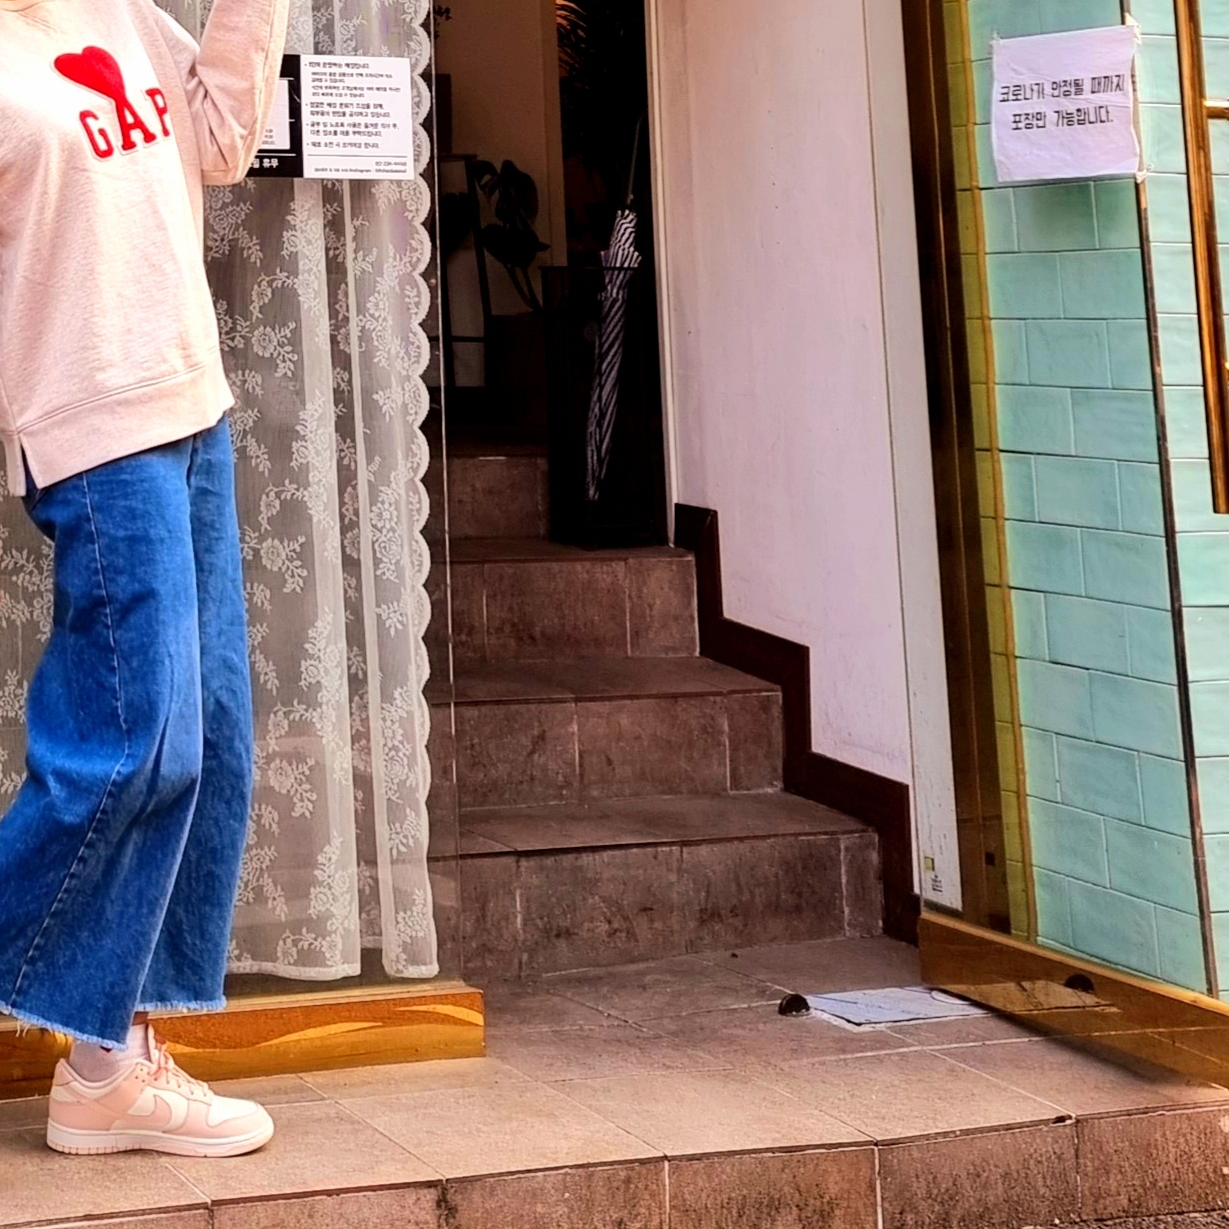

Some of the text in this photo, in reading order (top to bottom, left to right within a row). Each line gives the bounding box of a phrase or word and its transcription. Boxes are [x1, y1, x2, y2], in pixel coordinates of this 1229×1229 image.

[999, 74, 1125, 103] 코로나가 안정될 때까지
[78, 87, 171, 159] GAP
[1011, 105, 1114, 131] 포장만 가능합니다.
